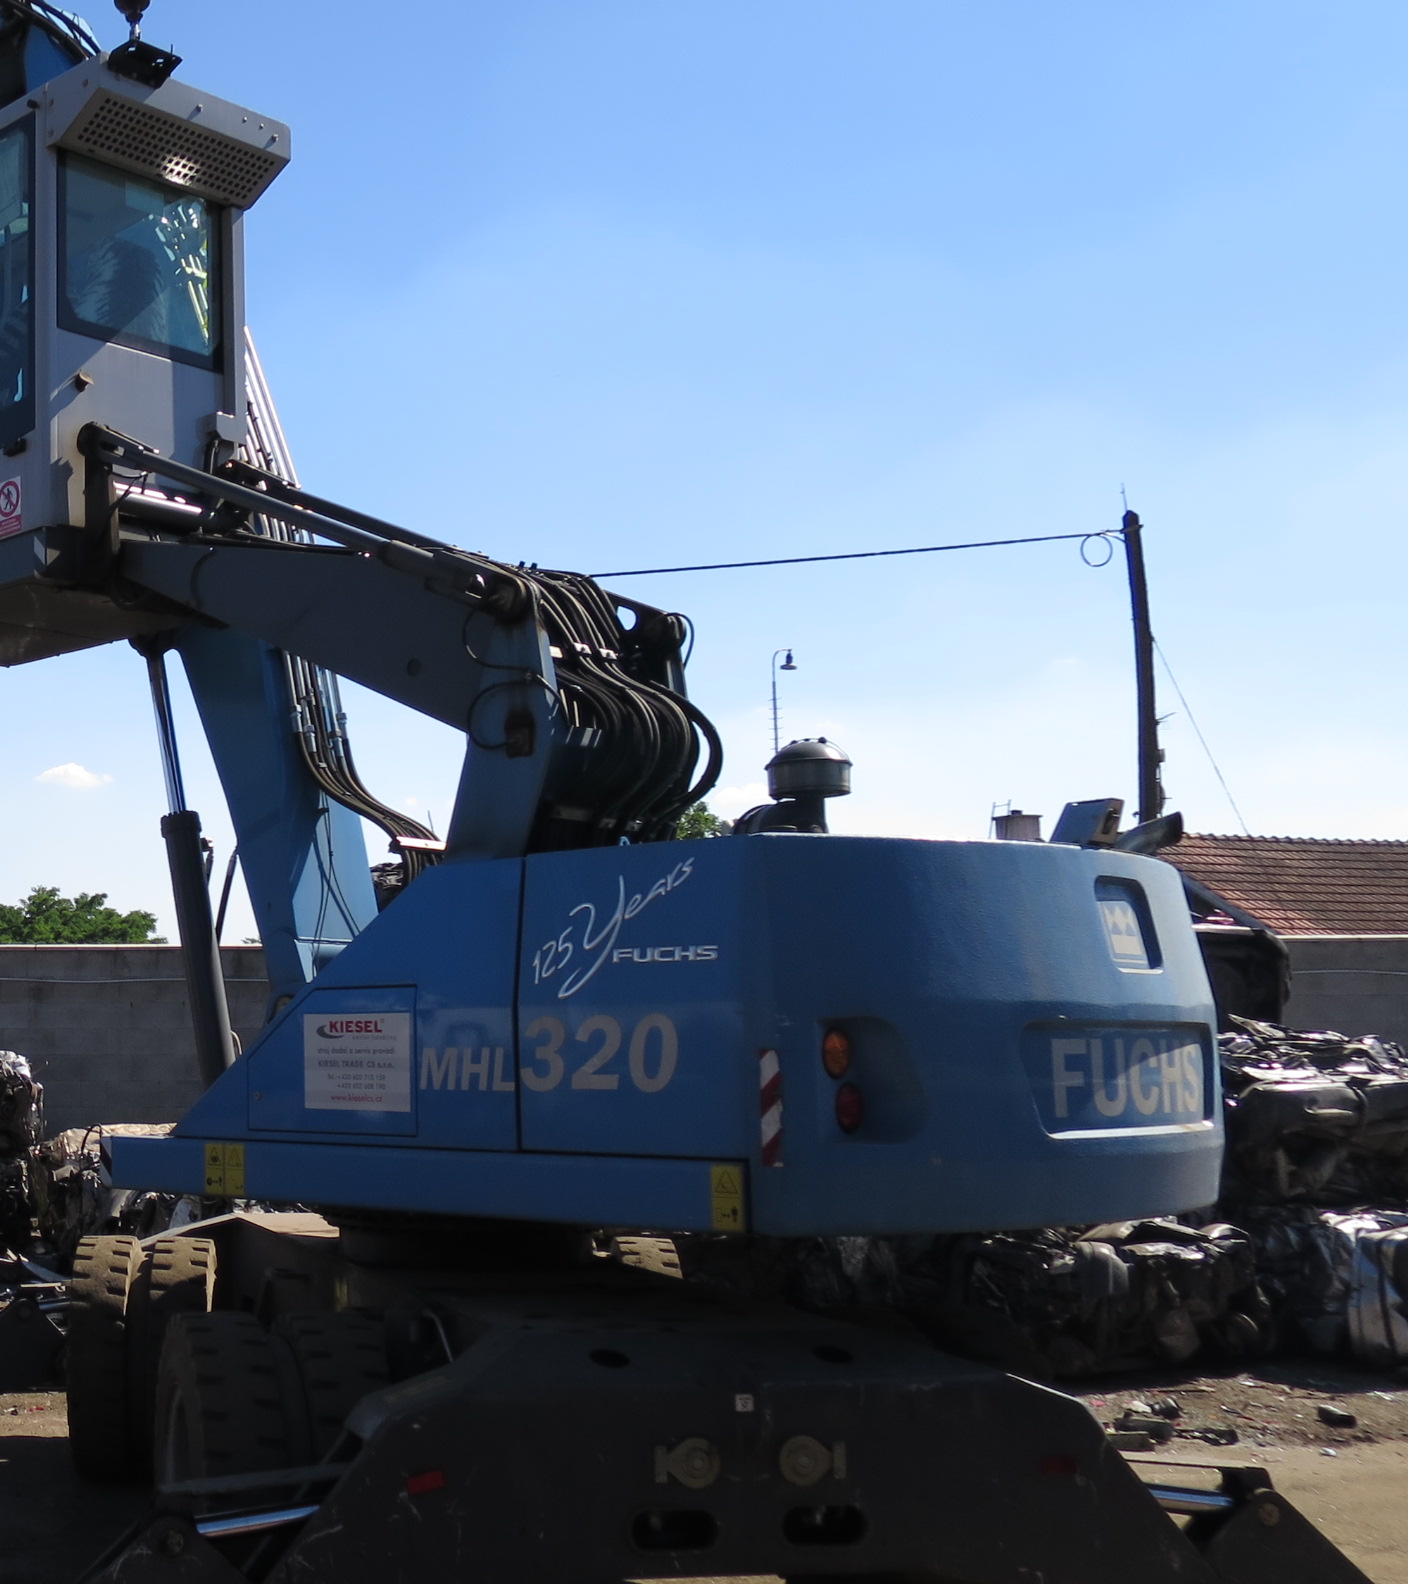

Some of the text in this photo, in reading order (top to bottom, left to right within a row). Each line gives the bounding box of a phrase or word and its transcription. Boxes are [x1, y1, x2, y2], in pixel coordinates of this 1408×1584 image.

[532, 857, 695, 999] 125 Years
[612, 945, 719, 963] FUCHS
[329, 1020, 382, 1033] KIESEL
[318, 1060, 340, 1068] KIESEL
[342, 1060, 363, 1068] TRADE
[419, 1013, 679, 1093] MHL 320
[1051, 1037, 1201, 1118] FUCHS
